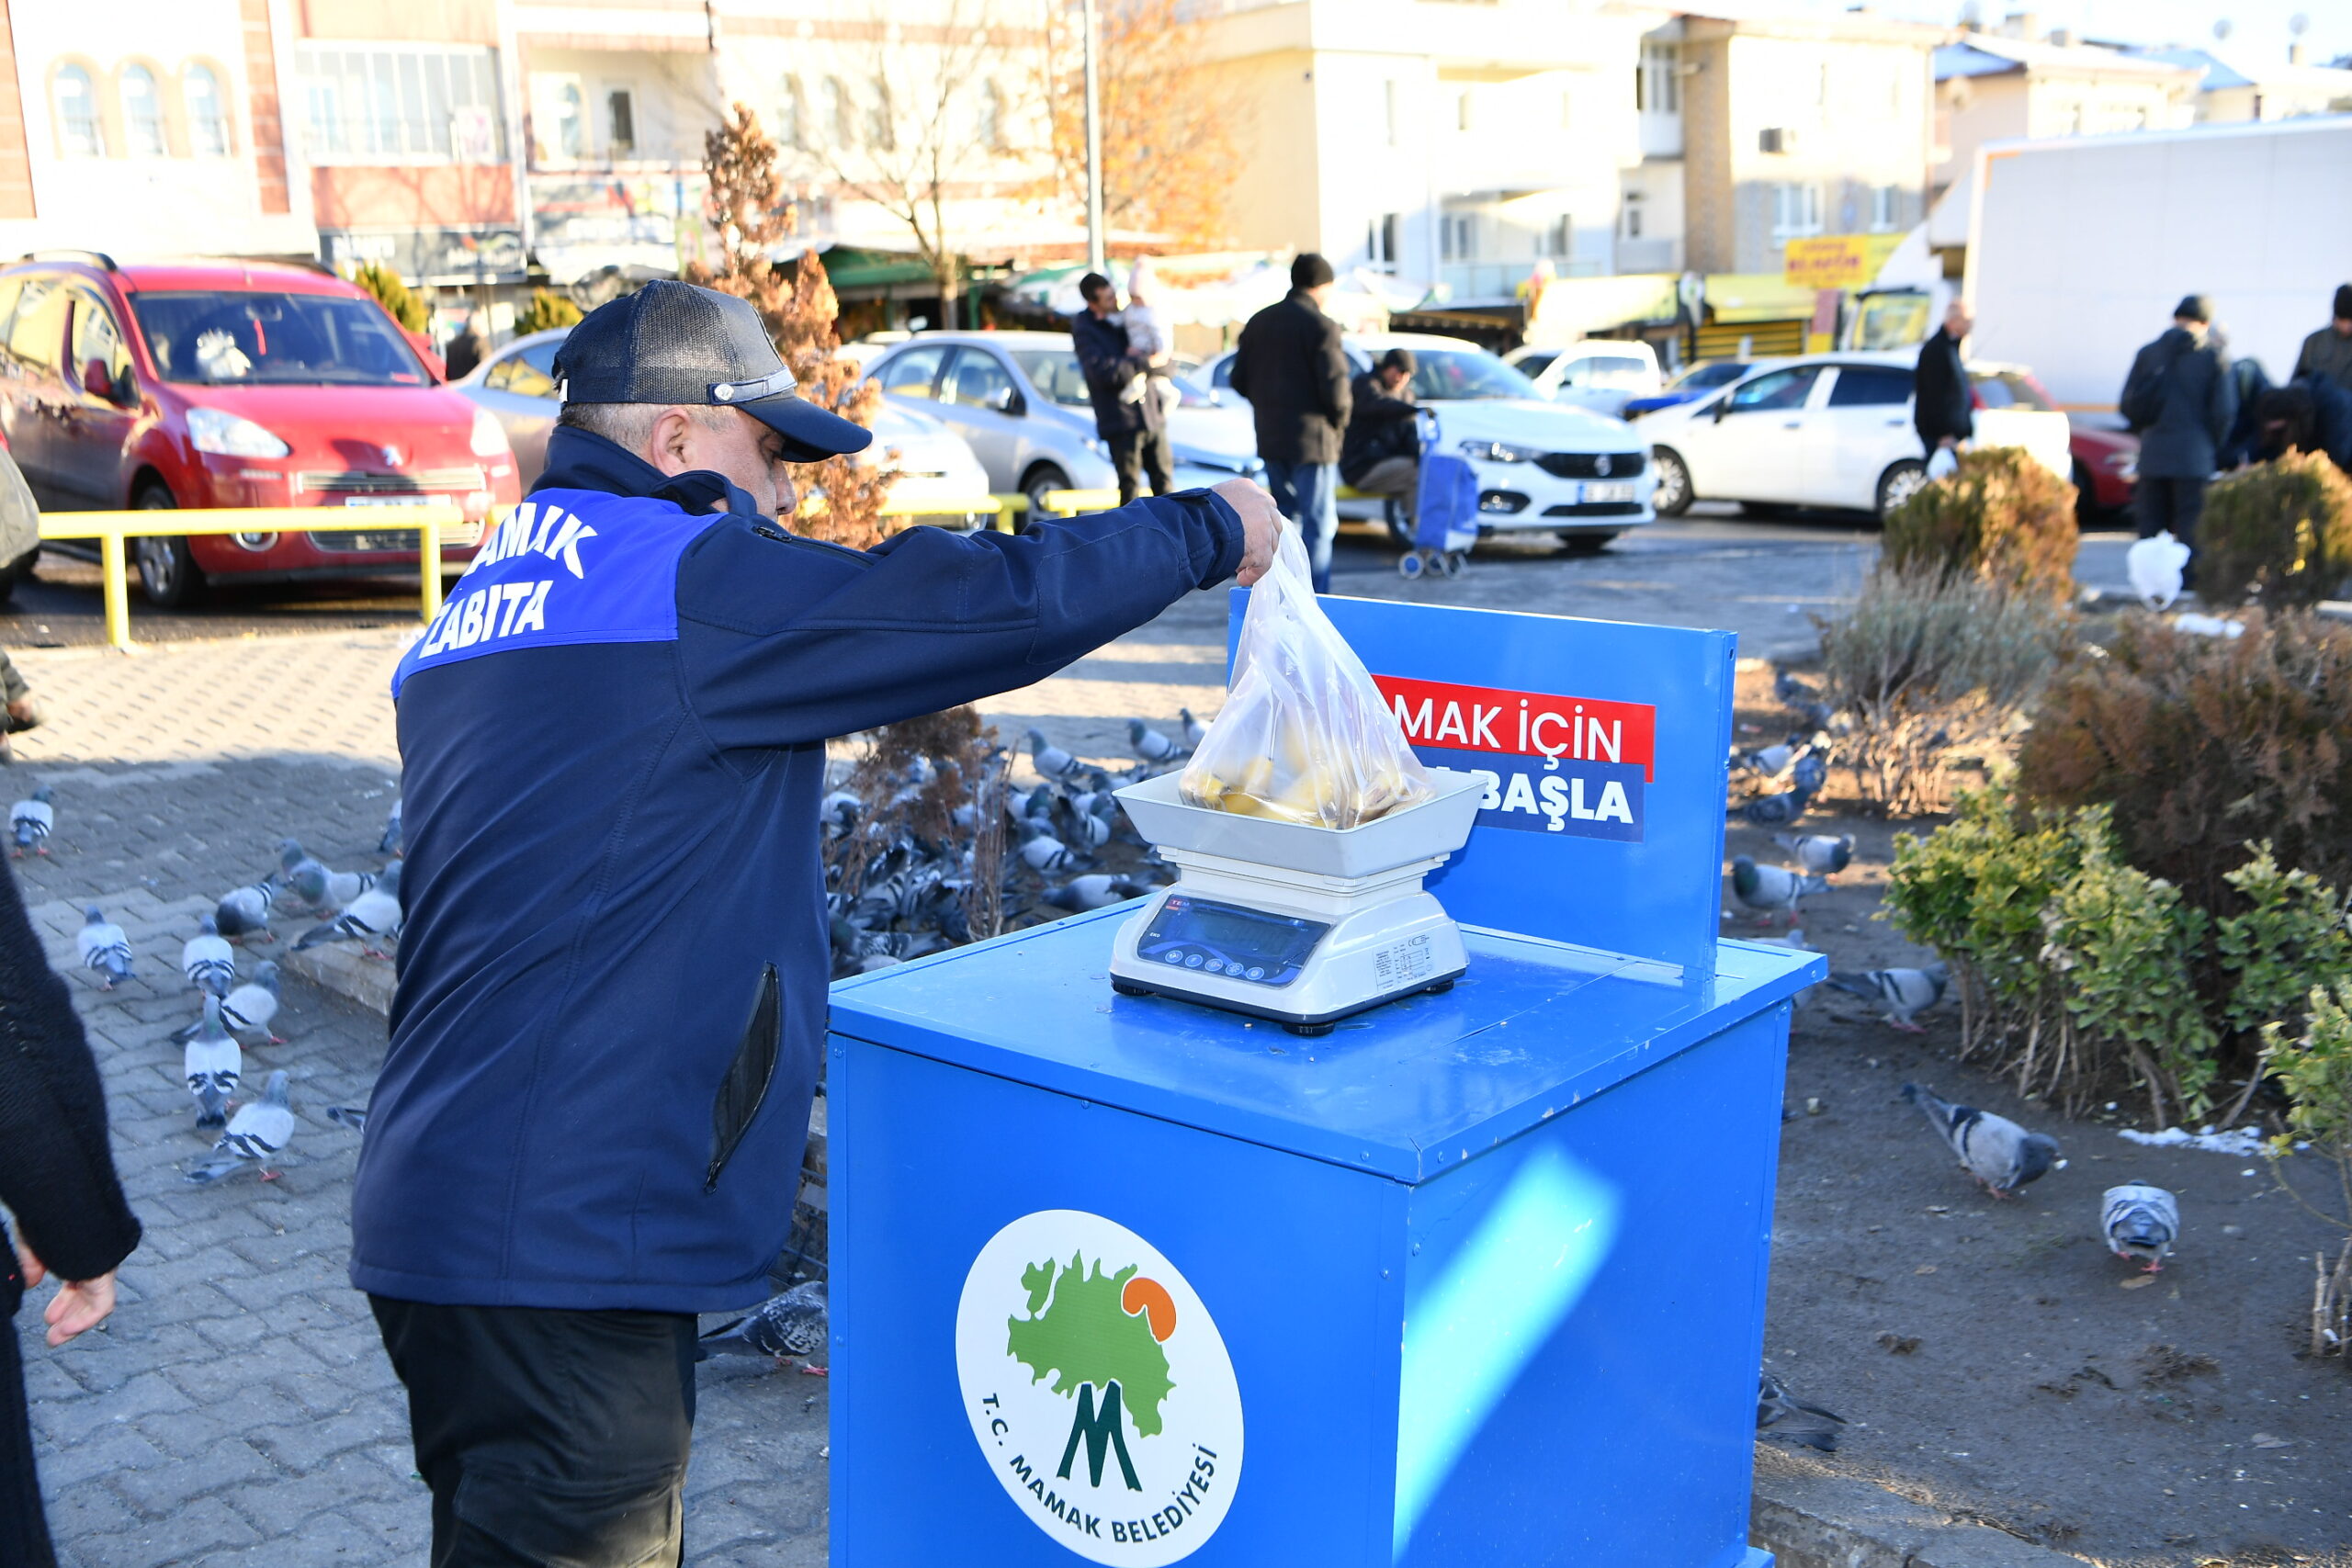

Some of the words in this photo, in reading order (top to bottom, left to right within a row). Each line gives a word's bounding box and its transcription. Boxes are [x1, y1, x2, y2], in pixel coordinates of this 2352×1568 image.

[462, 502, 598, 580] AMAK
[418, 580, 554, 660] ZABITA
[1394, 694, 1502, 749] MAK
[1518, 698, 1622, 770] İÇİN
[1471, 769, 1634, 831] BAŞLA
[982, 1393, 1009, 1446] T.C.
[1010, 1454, 1102, 1539] MAMAK
[1112, 1442, 1217, 1543] BELEDİYESİ
